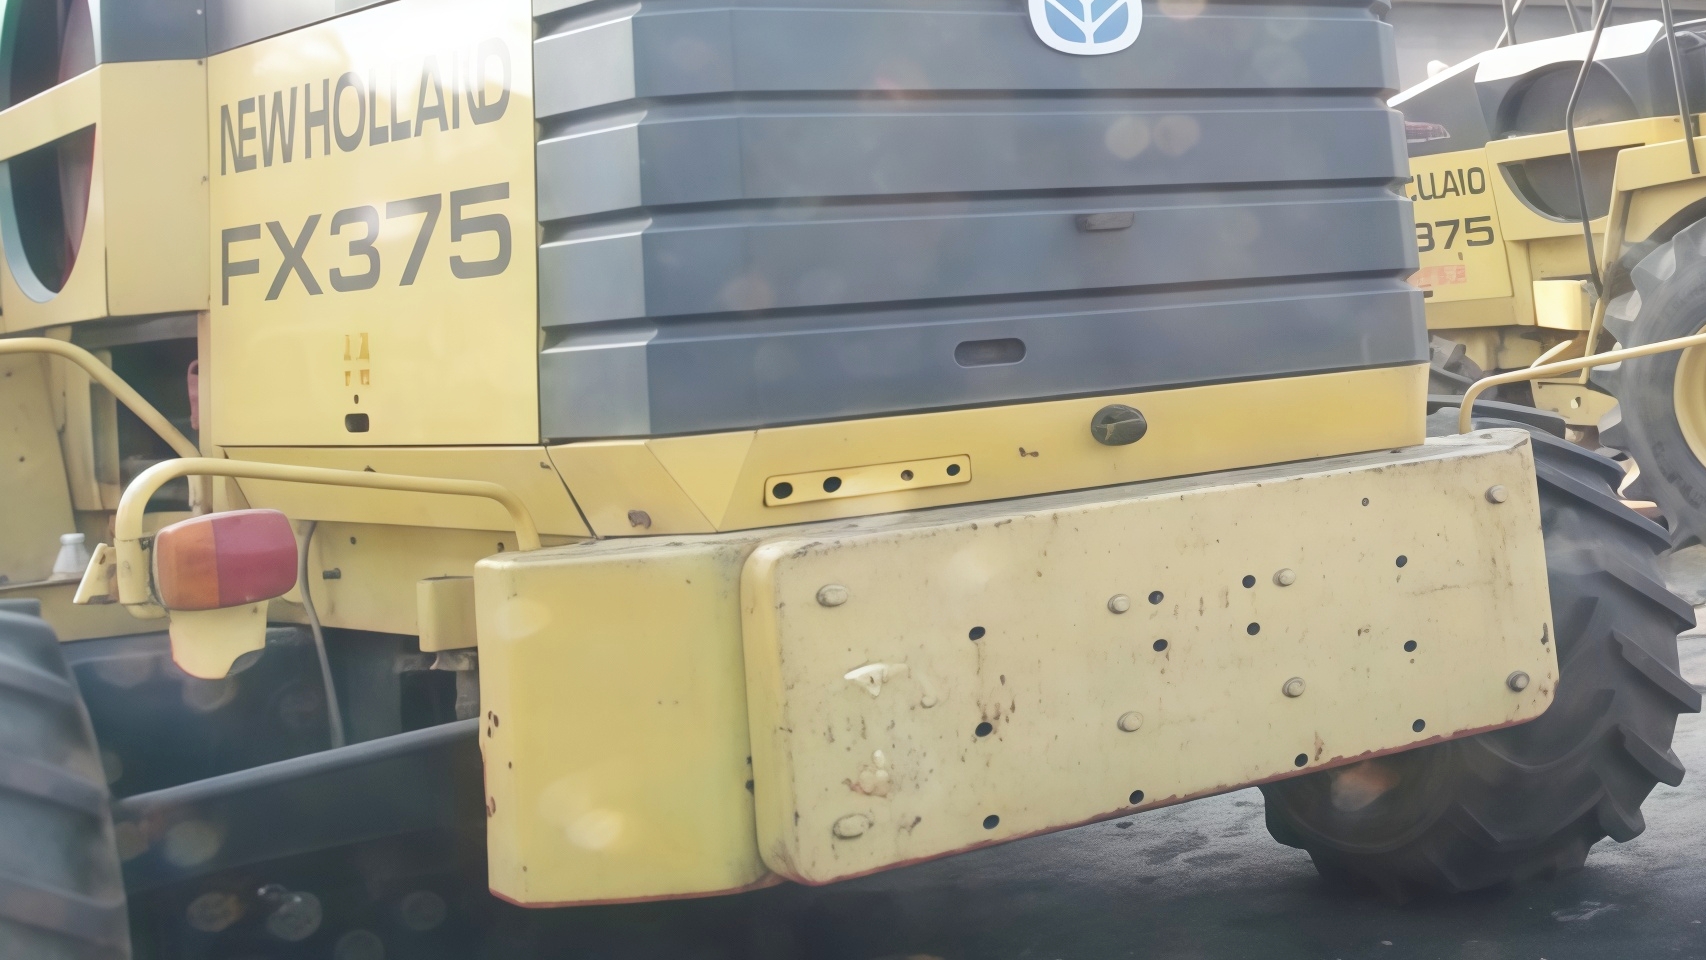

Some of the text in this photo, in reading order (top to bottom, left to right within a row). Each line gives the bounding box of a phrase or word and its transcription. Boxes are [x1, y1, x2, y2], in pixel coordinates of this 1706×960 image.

[220, 37, 512, 176] NEW HOLLAND
[220, 181, 512, 306] FX375
[1416, 215, 1495, 253] 375
